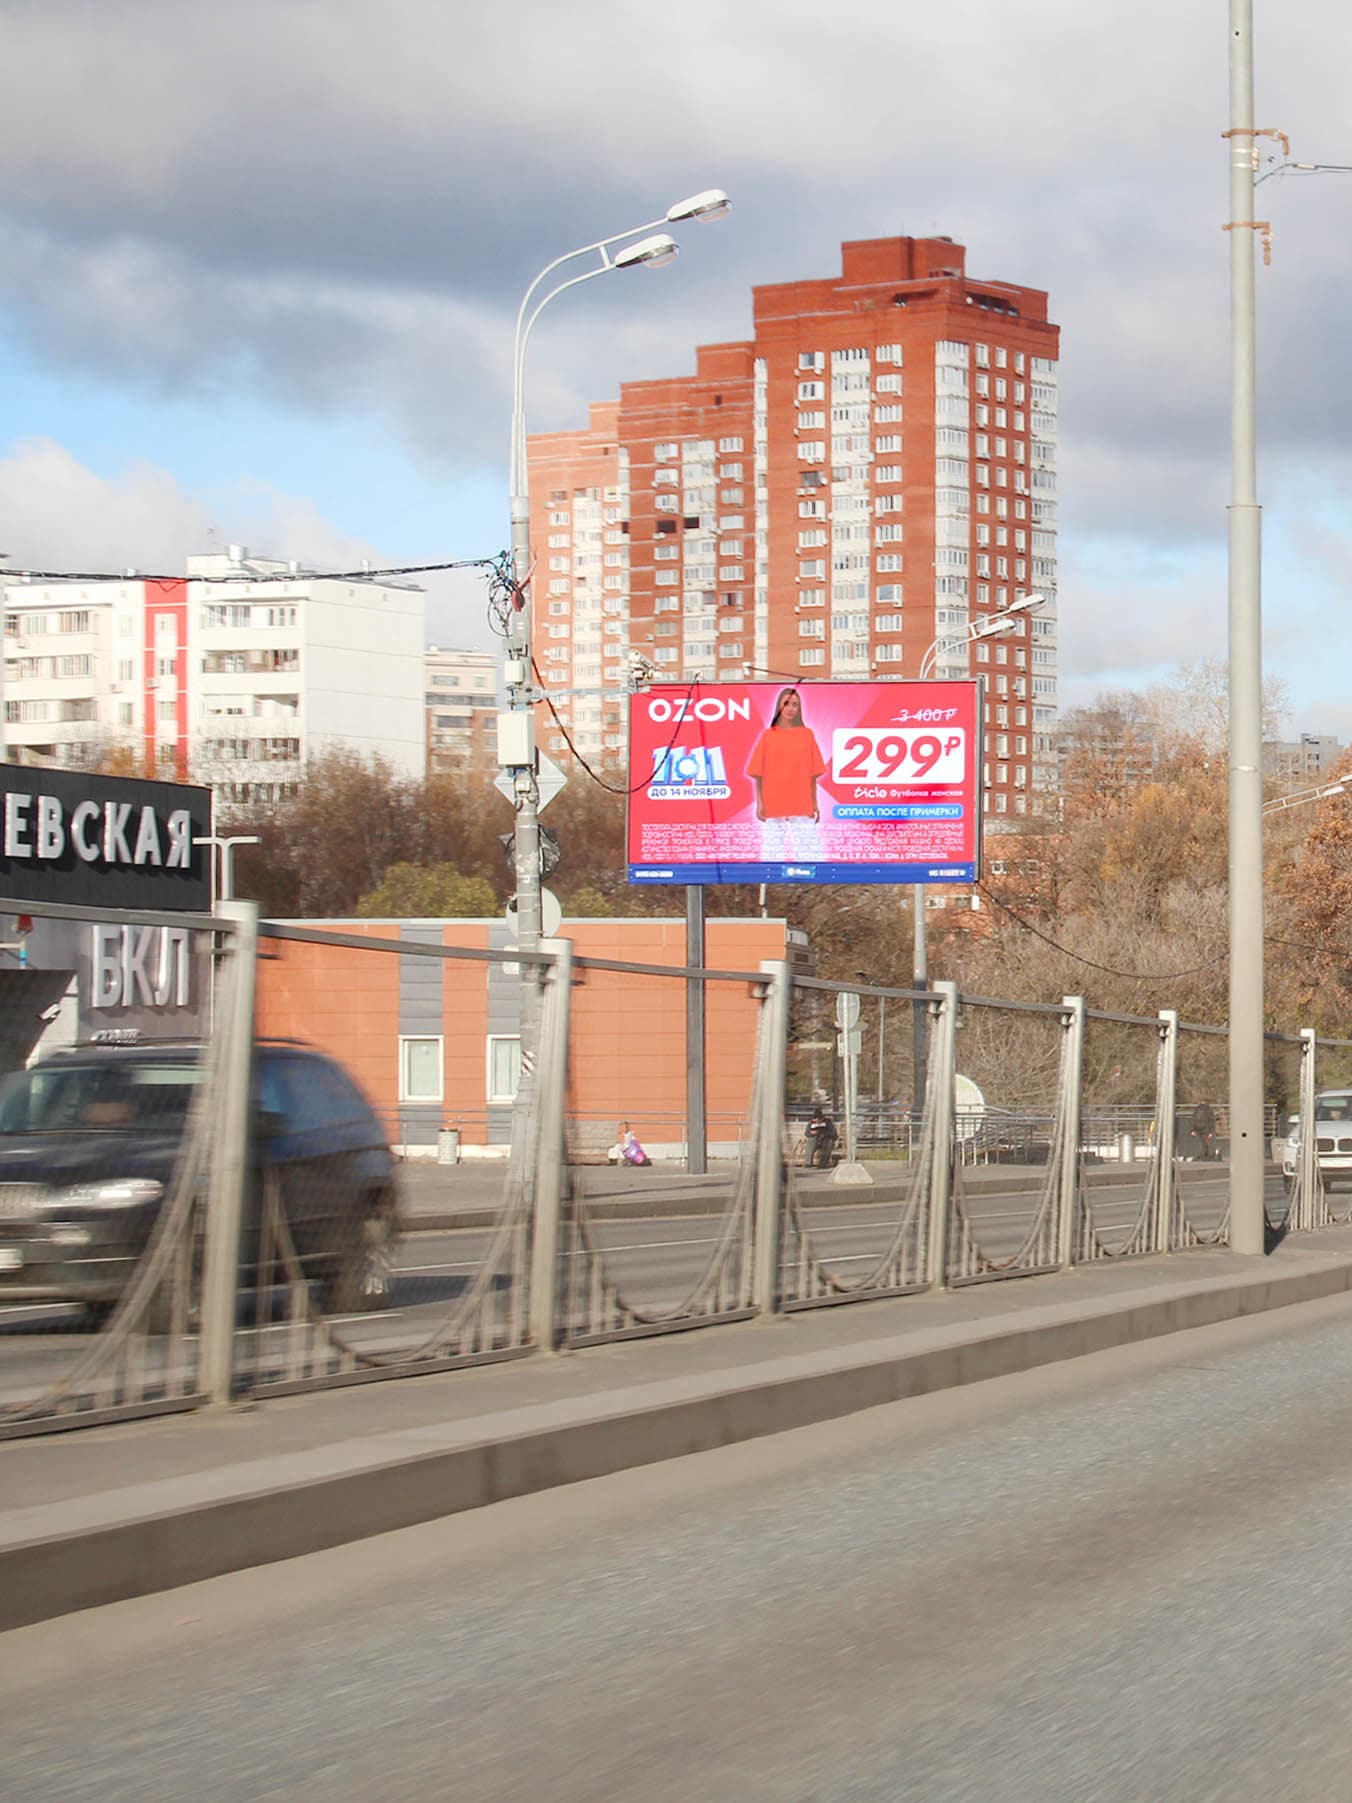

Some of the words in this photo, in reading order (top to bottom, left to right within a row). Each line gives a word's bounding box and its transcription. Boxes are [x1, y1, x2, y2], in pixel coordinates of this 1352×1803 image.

[648, 697, 750, 722] OZON
[651, 788, 668, 797] ДО
[683, 787, 727, 796] НОЯБРЯ
[837, 807, 875, 817] ОПЛАТА
[877, 807, 908, 817] ПОСЛЕ
[910, 807, 959, 817] ПРИМЕРКИ
[4, 792, 192, 869] ЕВСКАЯ
